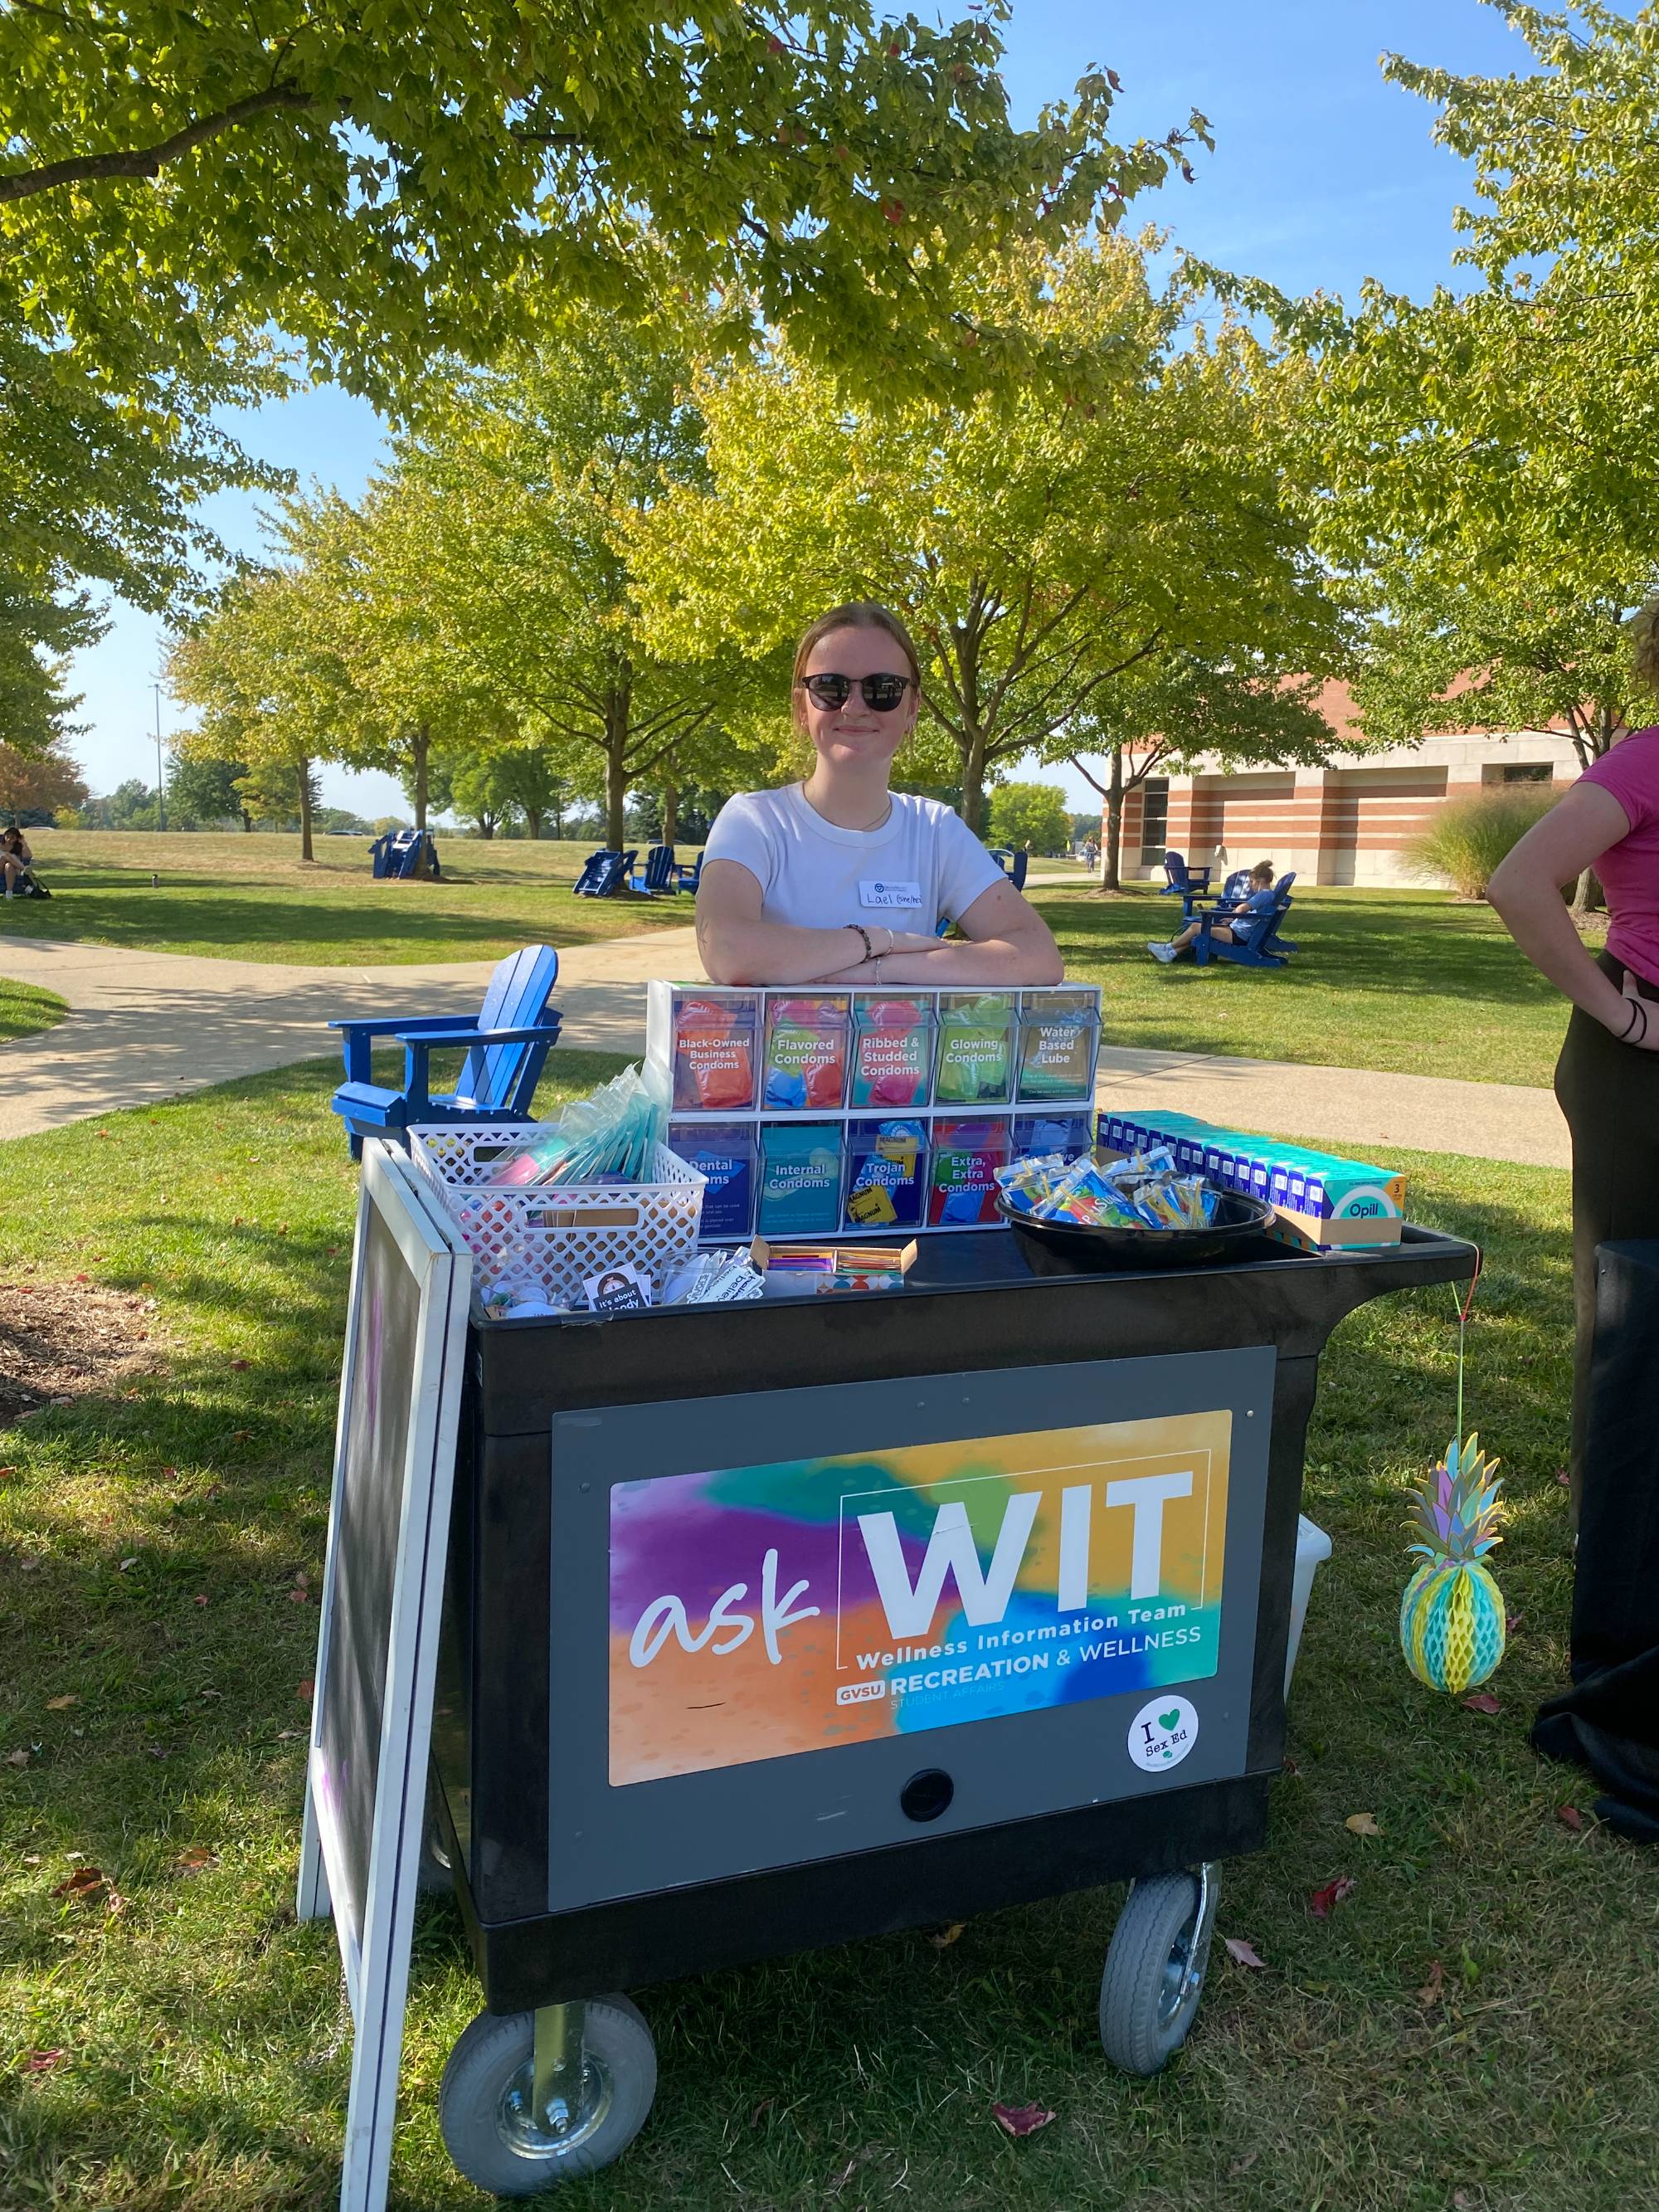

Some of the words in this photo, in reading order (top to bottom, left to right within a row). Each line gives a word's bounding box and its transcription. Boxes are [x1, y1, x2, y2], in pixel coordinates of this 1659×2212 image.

[867, 894, 893, 904] Lael
[1039, 1027, 1074, 1037] Water
[679, 1039, 750, 1048] Black-Owned
[777, 1040, 834, 1050] Flavored
[863, 1038, 907, 1049] Ribbed
[911, 1038, 919, 1048] &
[950, 1039, 998, 1050] Glowing
[1039, 1040, 1074, 1050] Based
[690, 1050, 736, 1059] Business
[775, 1054, 836, 1065] Condoms
[864, 1051, 917, 1062] Studded
[946, 1052, 1002, 1063] Condoms
[1041, 1053, 1070, 1064] Lube
[688, 1061, 739, 1070] Condoms
[861, 1065, 920, 1076] Condoms
[689, 1159, 732, 1171] Dental
[951, 1157, 986, 1167] Extra,
[776, 1164, 825, 1176] Internal
[866, 1162, 906, 1174] Trojan
[708, 1175, 730, 1185] ms
[952, 1170, 984, 1180] Extra
[769, 1178, 830, 1189] Condoms
[855, 1177, 914, 1186] Condoms
[938, 1182, 995, 1193] Condoms
[1394, 1184, 1400, 1193] 3
[858, 1206, 882, 1221] AGNUM
[1350, 1203, 1379, 1219] Opill
[599, 1299, 612, 1308] It's
[614, 1289, 636, 1303] about
[629, 1548, 821, 1668] ask
[857, 1471, 1194, 1640] WIT
[856, 1640, 968, 1671] Wellness
[978, 1615, 1118, 1650] Information
[1128, 1605, 1186, 1625] Team
[840, 1685, 881, 1701] GVSU
[891, 1652, 1048, 1696] RECREATION
[1057, 1649, 1071, 1666] &
[1079, 1626, 1202, 1662] WELLNESS
[890, 1690, 950, 1710] STUDENT
[953, 1681, 1005, 1699] AFFAIRS
[1141, 1722, 1155, 1744] I
[1146, 1740, 1169, 1757] Sex
[1170, 1729, 1188, 1745] Ed
